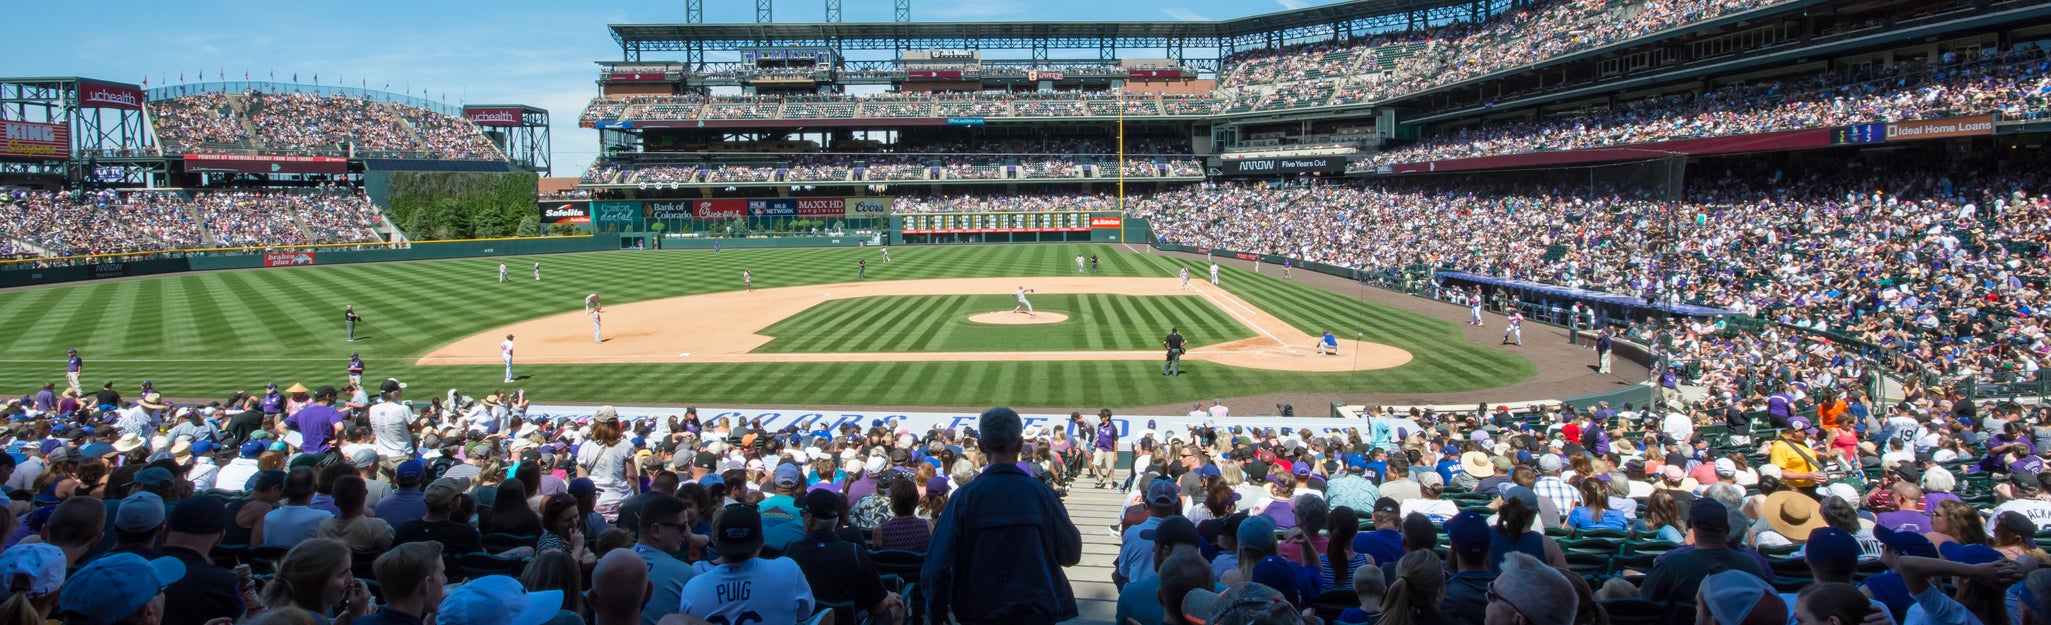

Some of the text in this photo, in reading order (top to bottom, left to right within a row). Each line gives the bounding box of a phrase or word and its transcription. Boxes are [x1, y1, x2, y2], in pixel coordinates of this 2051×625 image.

[90, 89, 137, 105] uchealth
[471, 111, 513, 122] uchealth
[5, 122, 55, 141] KING
[1899, 122, 1992, 136] Ideal Home Loans
[7, 140, 56, 157] Soopers
[1239, 160, 1274, 170] ARROW
[654, 202, 685, 211] Bank of
[799, 200, 844, 208] MAXX HD
[856, 202, 884, 212] Coors
[600, 209, 633, 221] dental
[654, 210, 692, 219] Colorado
[1900, 429, 1914, 442] 19
[716, 581, 752, 604] PUIG
